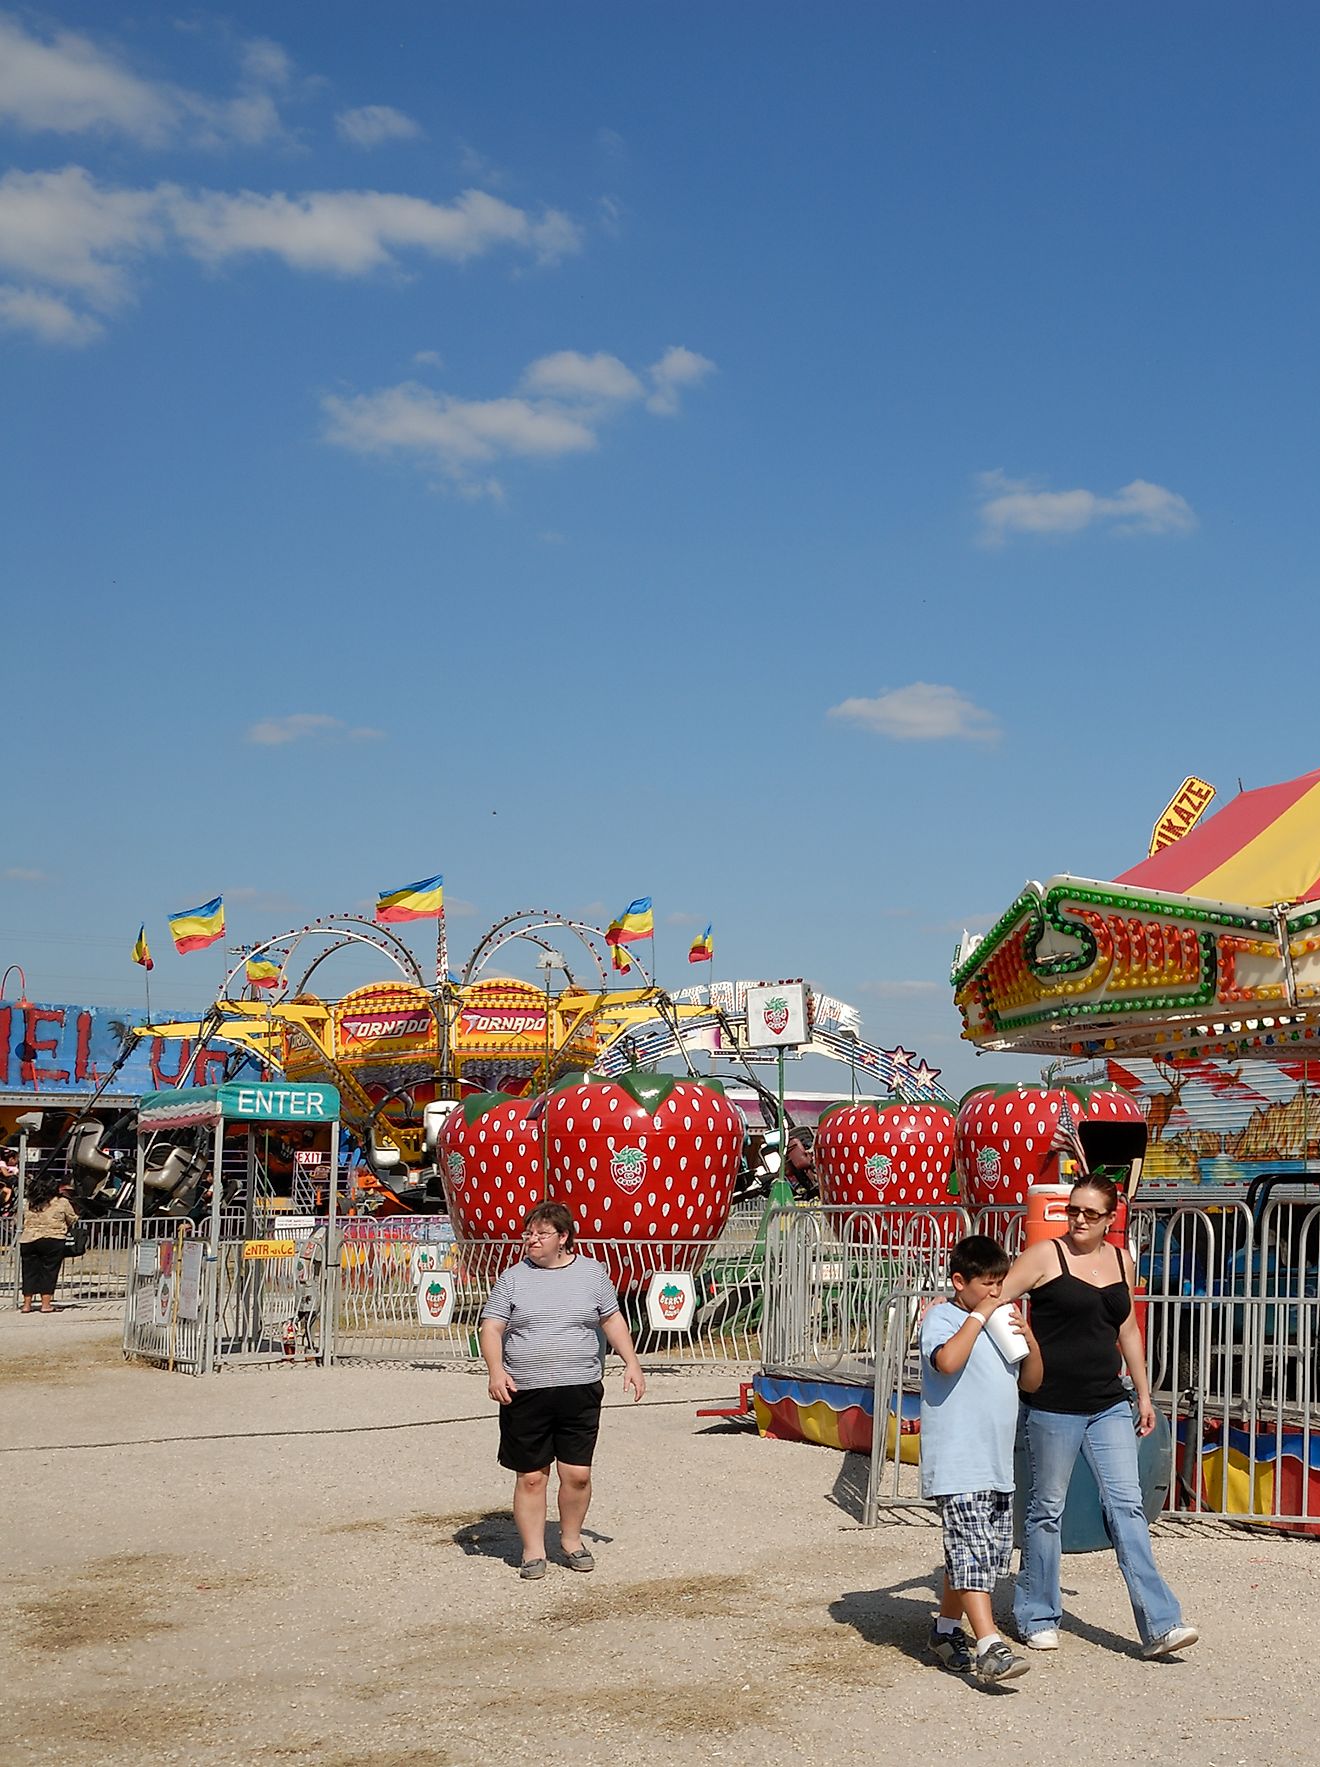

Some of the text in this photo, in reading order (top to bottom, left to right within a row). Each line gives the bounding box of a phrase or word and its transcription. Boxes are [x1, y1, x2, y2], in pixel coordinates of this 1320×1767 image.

[341, 1017, 431, 1045] TORNADO
[461, 1013, 547, 1036] TORNADO
[238, 1089, 324, 1115] ENTER
[297, 1153, 320, 1163] EXIT
